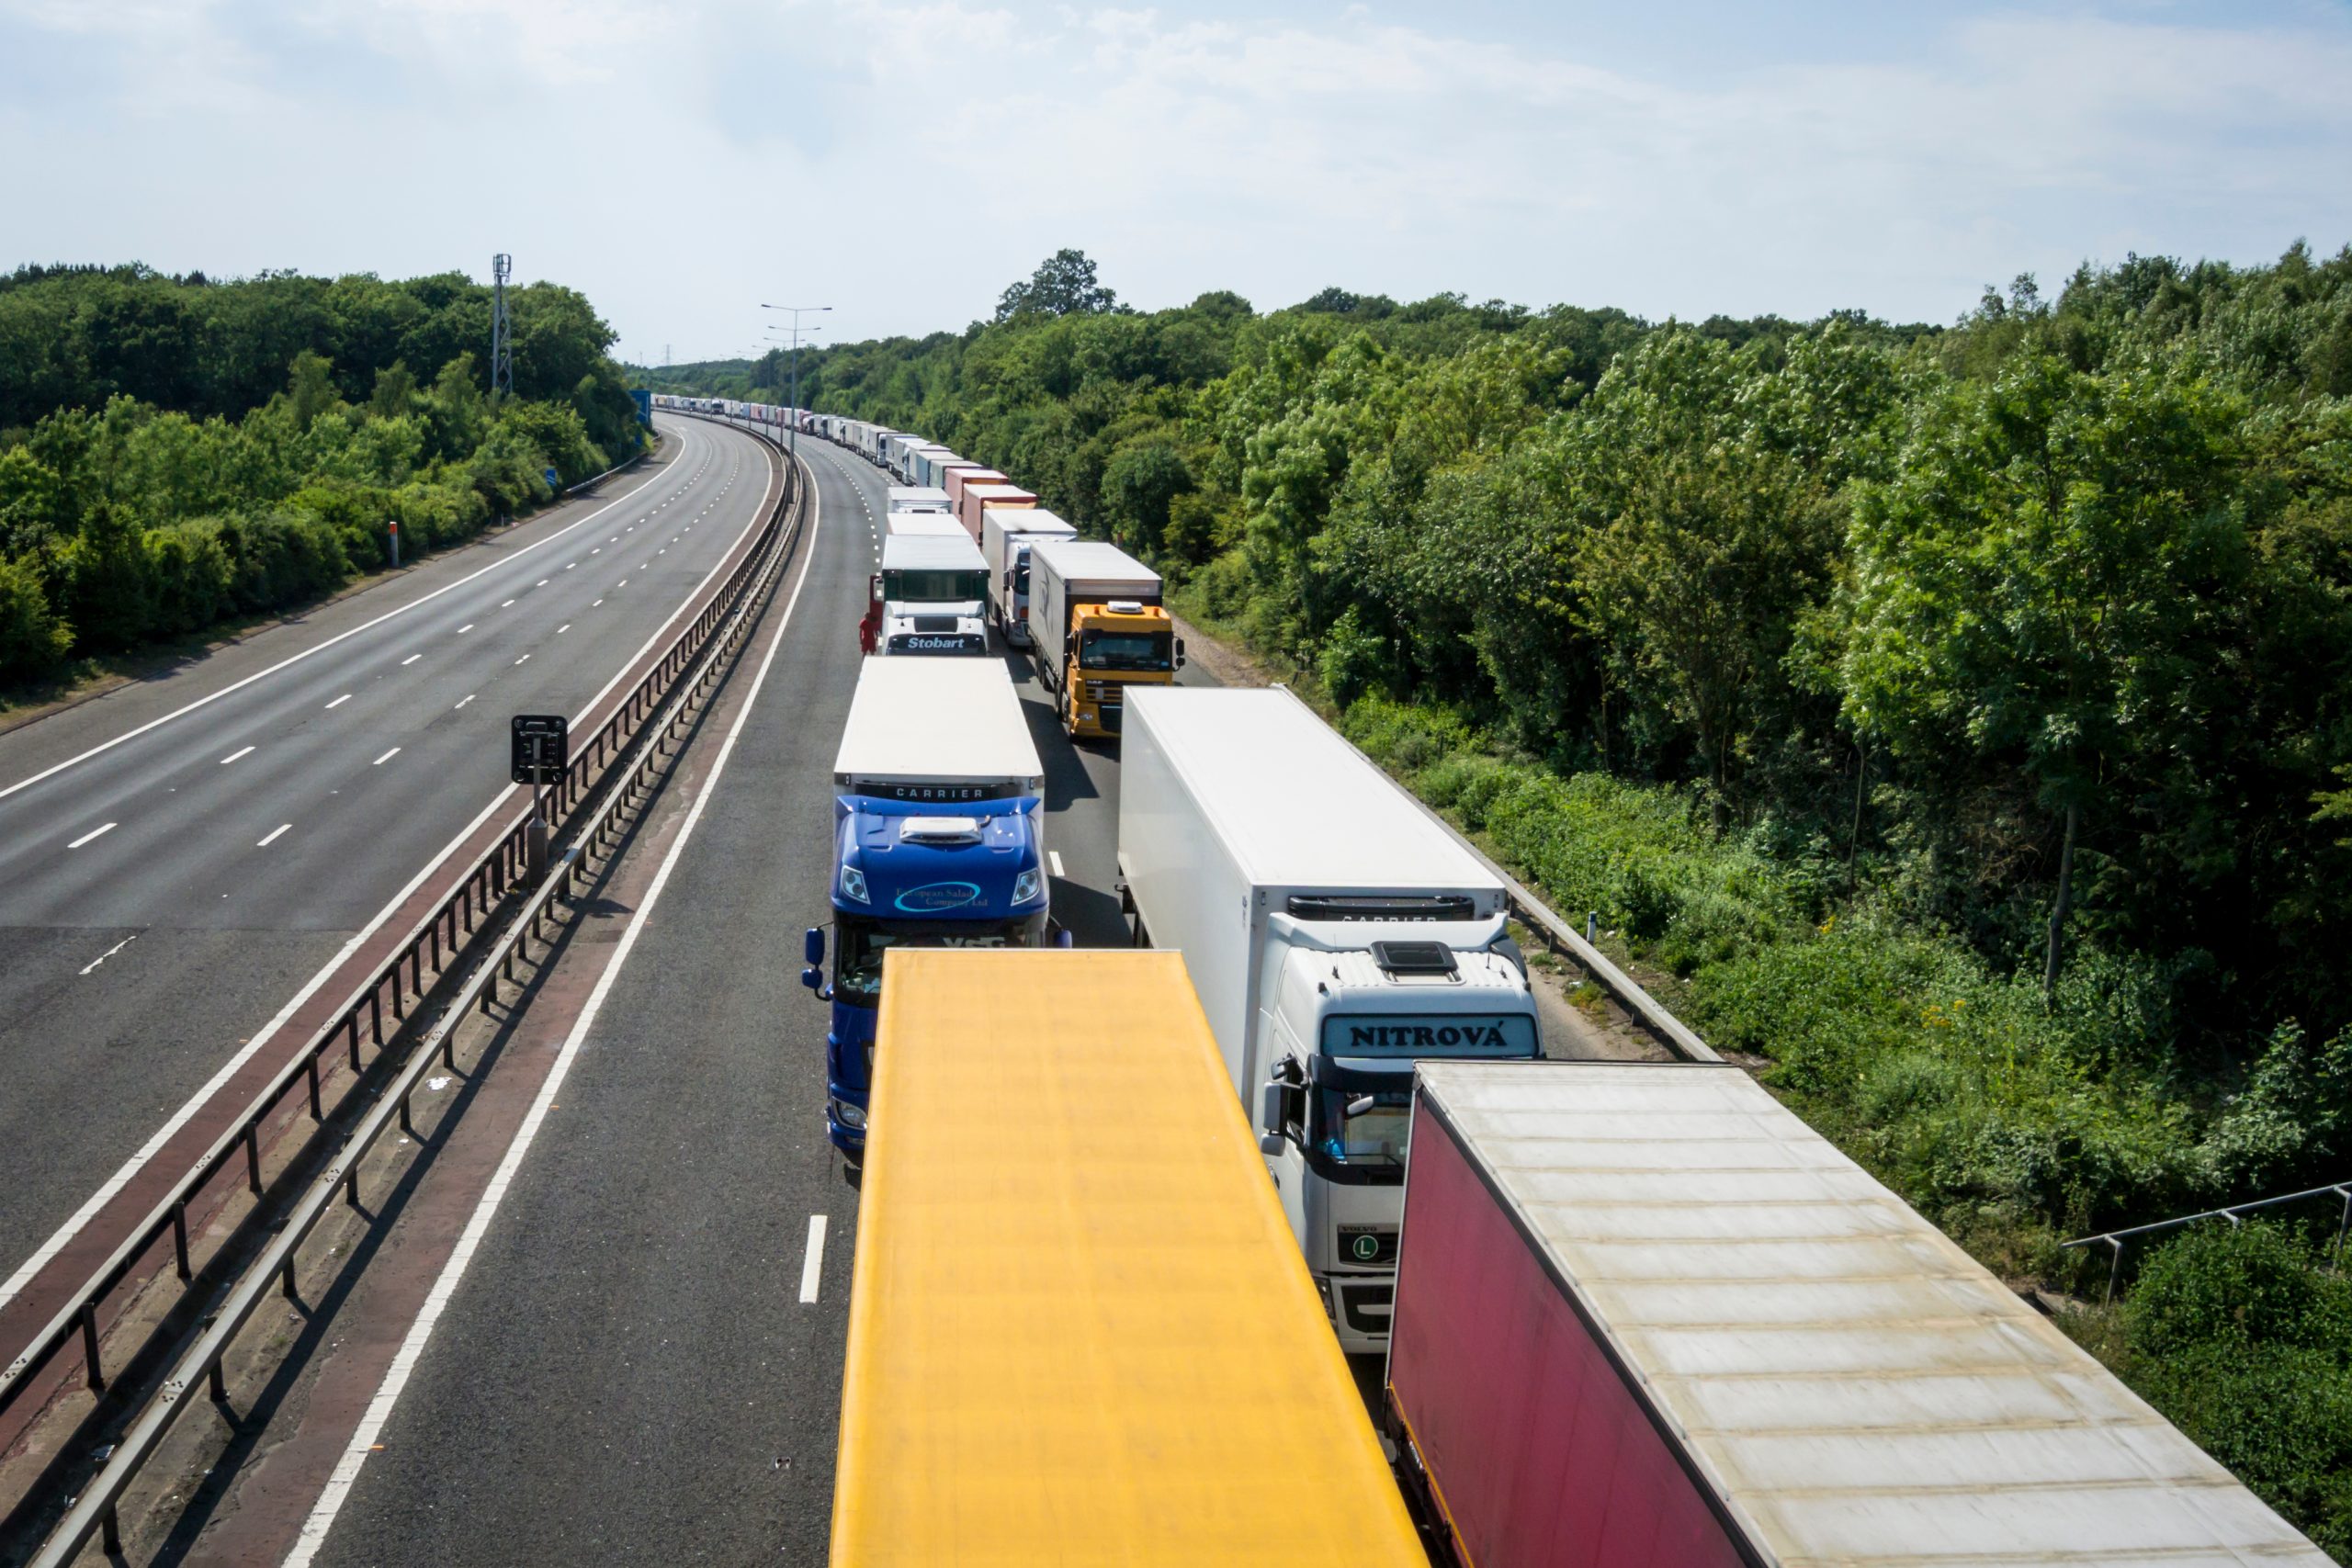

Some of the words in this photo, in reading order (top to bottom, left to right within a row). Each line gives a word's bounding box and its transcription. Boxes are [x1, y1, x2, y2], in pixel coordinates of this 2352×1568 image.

[908, 637, 965, 649] Stobart
[897, 788, 982, 798] CARRIER
[1350, 1021, 1508, 1047] NITROVÁ
[1360, 1240, 1371, 1255] L
